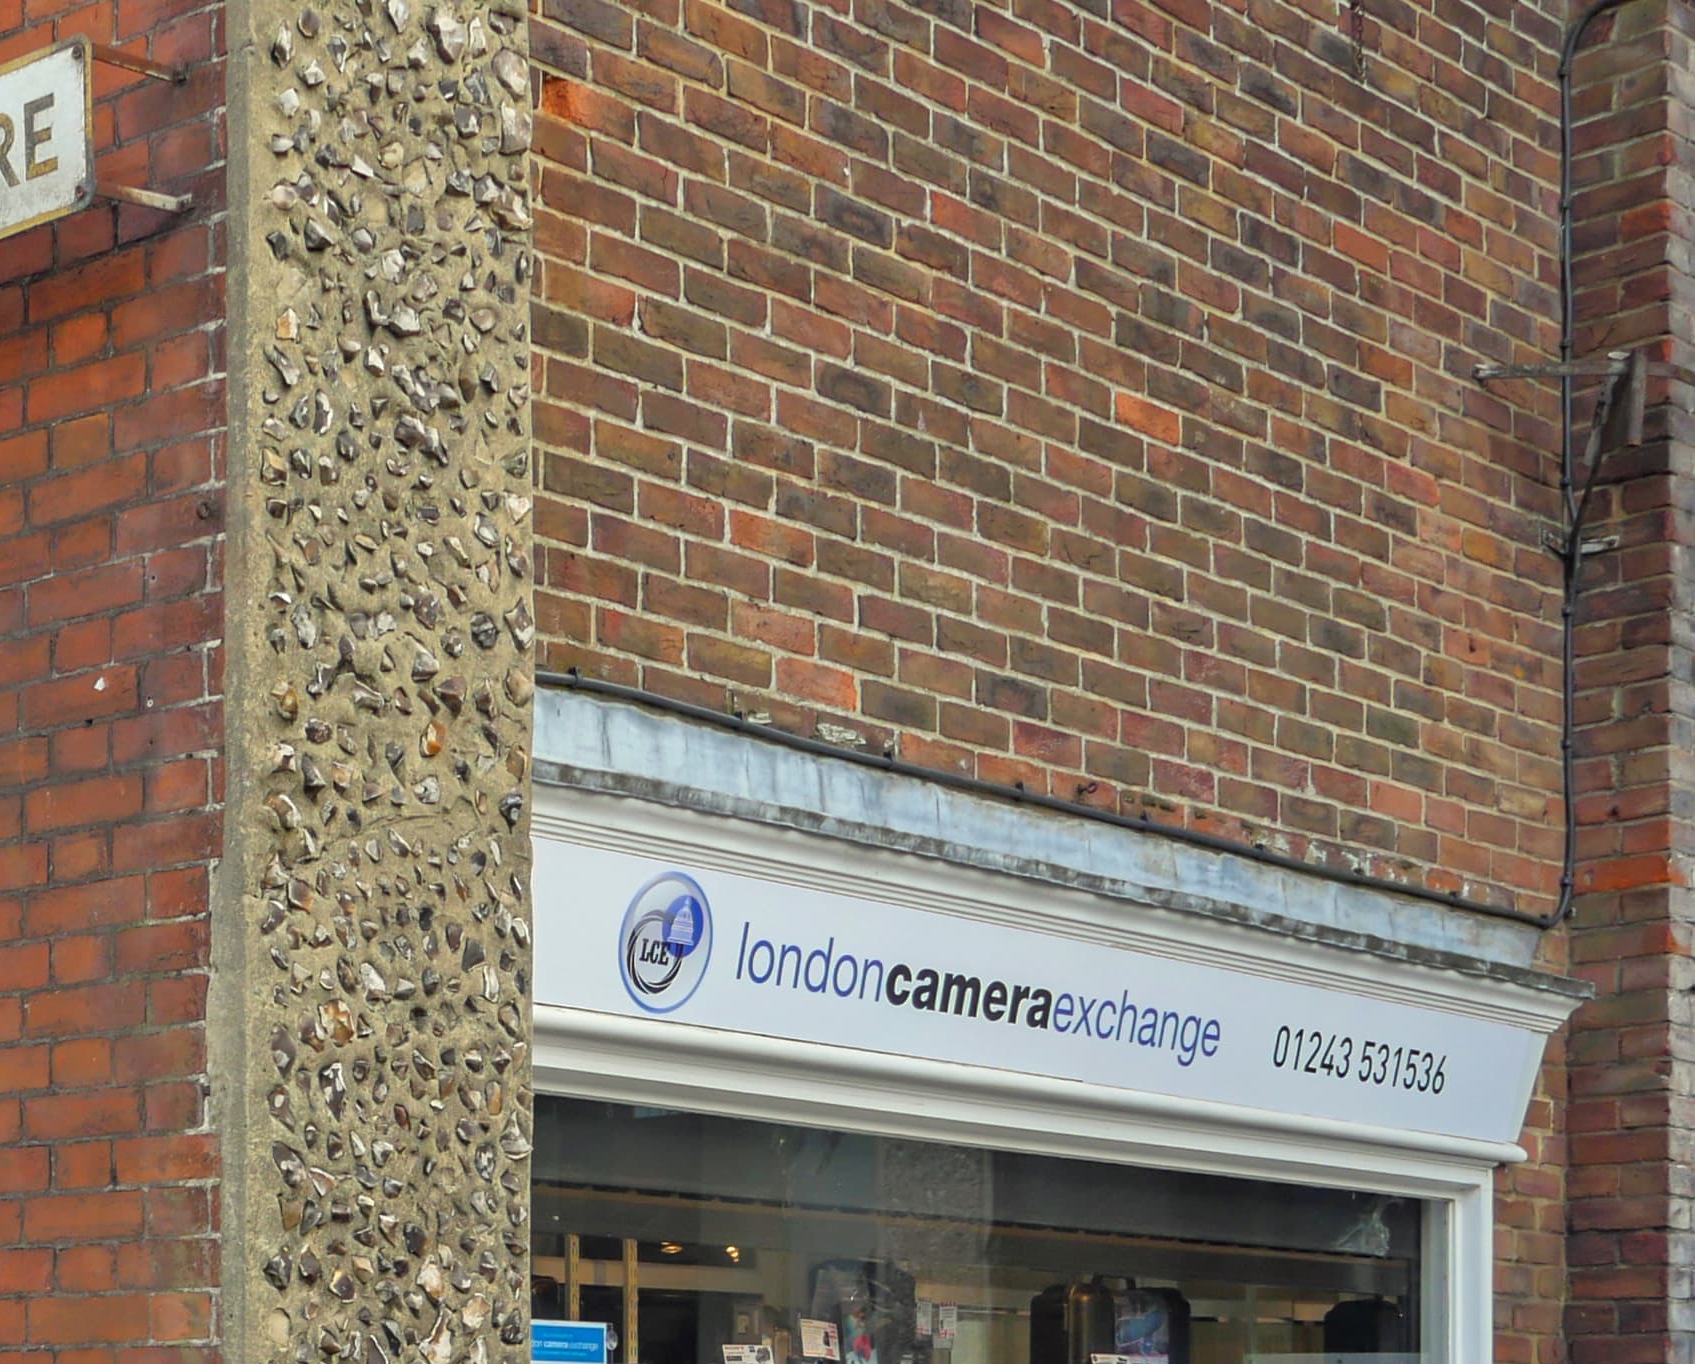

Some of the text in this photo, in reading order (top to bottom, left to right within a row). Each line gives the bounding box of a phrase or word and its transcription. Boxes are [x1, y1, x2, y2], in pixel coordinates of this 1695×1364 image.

[639, 938, 670, 966] LCE
[737, 921, 1448, 1095] londoncameraexchange 01243 531536
